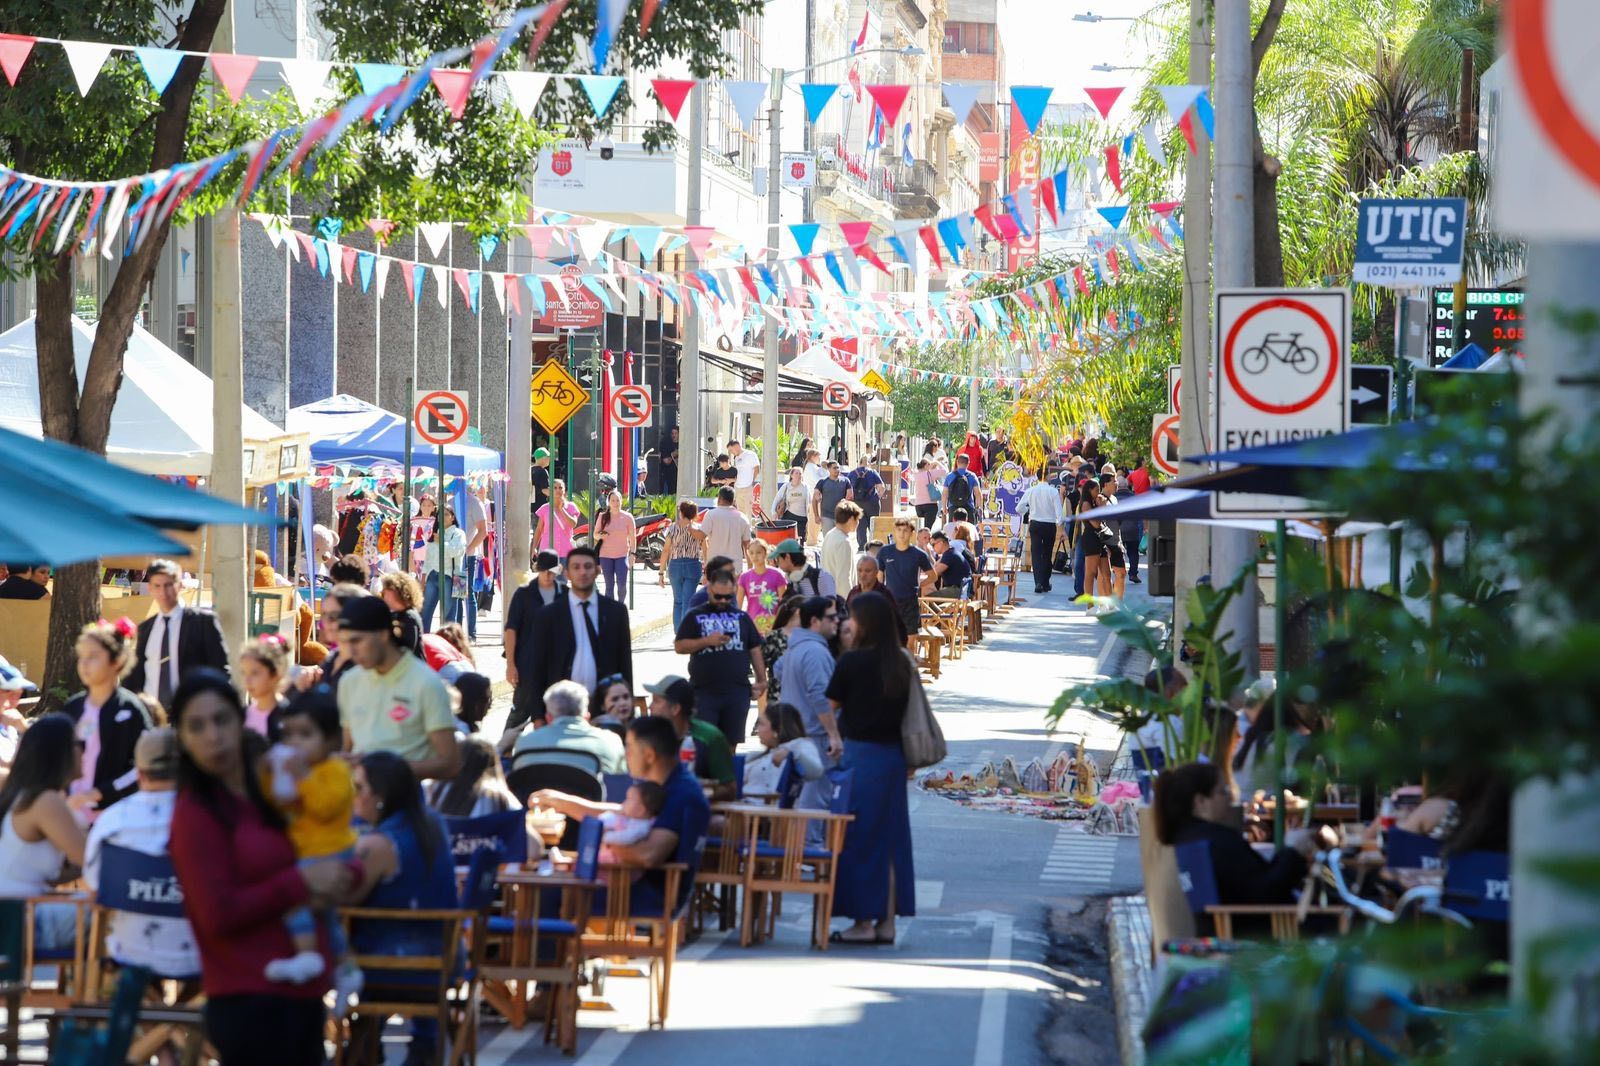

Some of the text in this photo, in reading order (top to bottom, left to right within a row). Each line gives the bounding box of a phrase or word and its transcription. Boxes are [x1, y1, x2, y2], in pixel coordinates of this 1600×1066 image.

[1366, 205, 1457, 248] UTIC
[1366, 265, 1447, 279] (021) 441 114
[567, 292, 583, 301] OTEL
[569, 300, 600, 310] OMINGO
[1435, 326, 1472, 340] Euo
